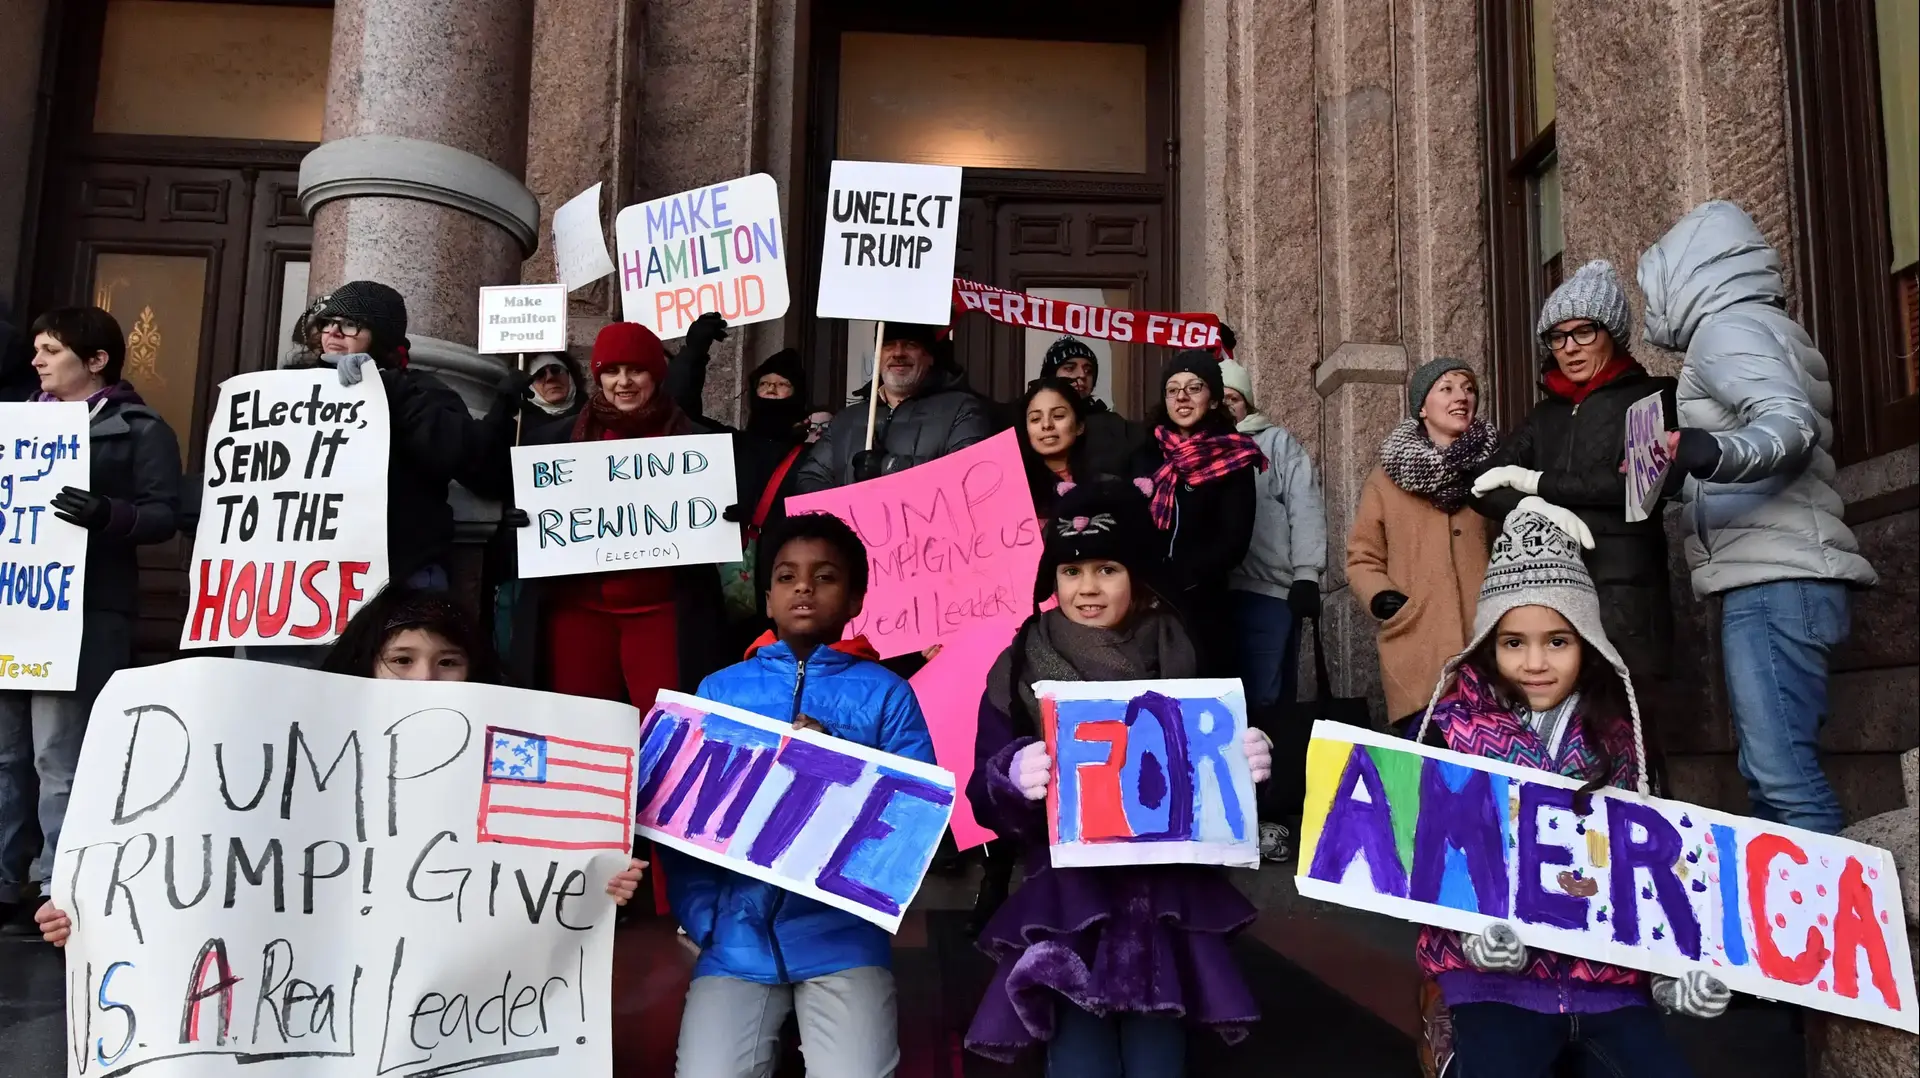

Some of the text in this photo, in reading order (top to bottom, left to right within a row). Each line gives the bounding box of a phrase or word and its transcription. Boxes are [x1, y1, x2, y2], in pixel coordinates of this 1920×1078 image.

[646, 185, 732, 244] MAKE
[832, 189, 953, 229] UNELECT
[623, 218, 778, 291] HAMILTON
[840, 232, 933, 269] TRUMP
[489, 313, 557, 325] Hamilton
[504, 296, 542, 308] Make
[655, 274, 765, 332] PROUD
[958, 290, 1134, 342] PERILOUS
[500, 329, 545, 341] Proud
[15, 434, 81, 477] right
[208, 437, 291, 487] SEND
[533, 450, 709, 488] BE KIND
[217, 490, 344, 544] TO THE
[537, 497, 717, 549] REWIND
[805, 461, 1003, 547] UMP
[595, 543, 680, 566] (ELECTION)
[0, 561, 75, 612] HOUSE
[188, 559, 371, 641] HOUSE
[0, 654, 53, 679] Texas
[111, 704, 472, 842] DUMP
[1057, 691, 1246, 843] FOR
[637, 708, 954, 917] UNITE
[65, 831, 375, 945] TRUMP!
[1309, 743, 1902, 1011] AMERICA
[252, 937, 363, 1049] Real
[376, 936, 586, 1076] Leader!
